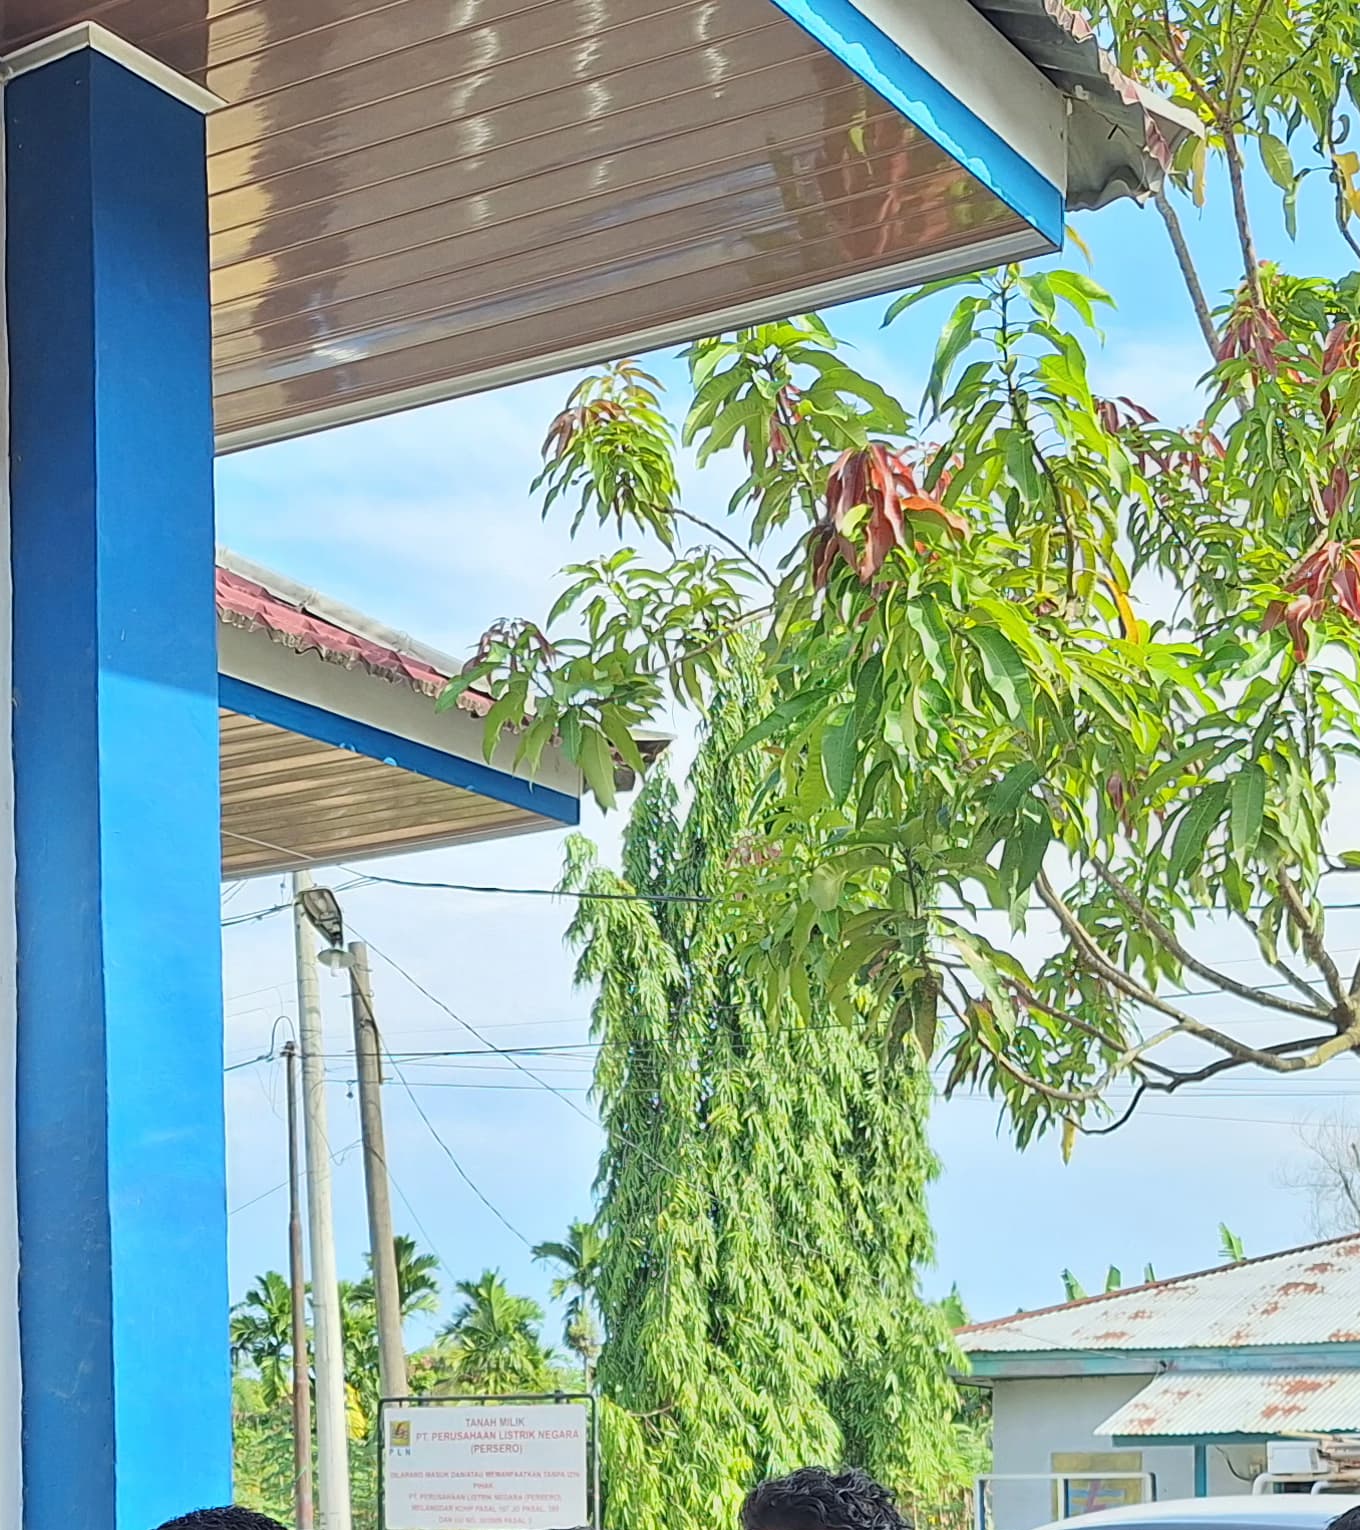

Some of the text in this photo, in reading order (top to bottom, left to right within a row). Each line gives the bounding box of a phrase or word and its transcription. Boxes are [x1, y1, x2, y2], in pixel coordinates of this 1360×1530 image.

[466, 1417, 525, 1427] TANAH MILIK
[431, 1431, 497, 1441] PERUSAHAAN
[499, 1431, 536, 1441] LISTRIK
[538, 1430, 580, 1440] NEGARA
[471, 1443, 524, 1455] (PERSERO)
